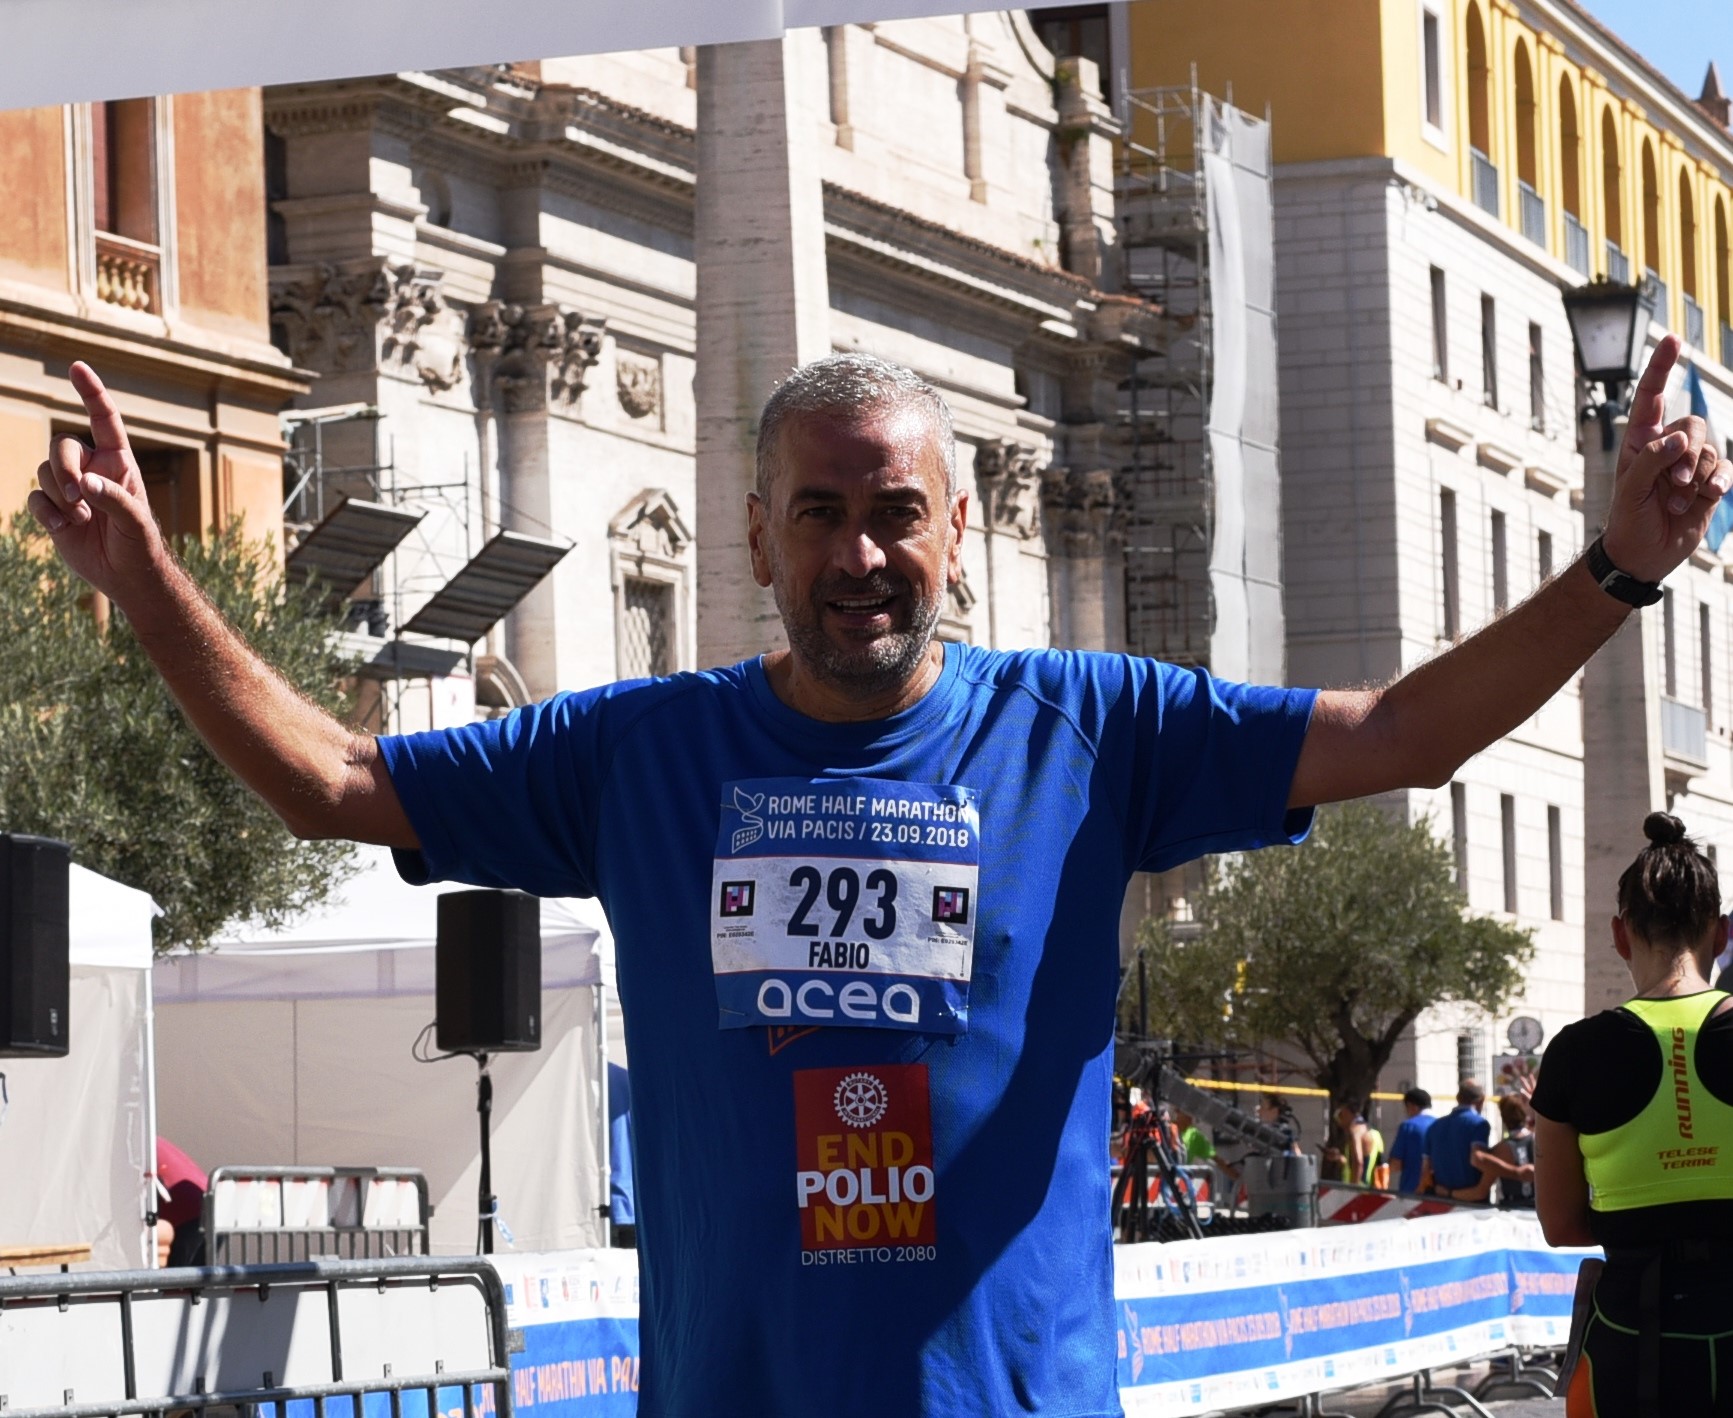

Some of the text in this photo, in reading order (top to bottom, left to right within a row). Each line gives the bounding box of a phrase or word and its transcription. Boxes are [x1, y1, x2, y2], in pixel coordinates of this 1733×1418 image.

[768, 795, 969, 824] ROME HALF MARATHON
[767, 820, 969, 848] VIA PACIS / 23.09.2018
[787, 865, 898, 940] 293
[808, 942, 870, 969] FABIO
[757, 979, 920, 1024] acea
[817, 1132, 914, 1171] END
[1656, 1146, 1719, 1160] TELESE
[1662, 1157, 1717, 1170] TERME
[797, 1165, 934, 1208] POLIO
[815, 1202, 924, 1242] NOW
[801, 1246, 937, 1266] DISTRETTO 2080
